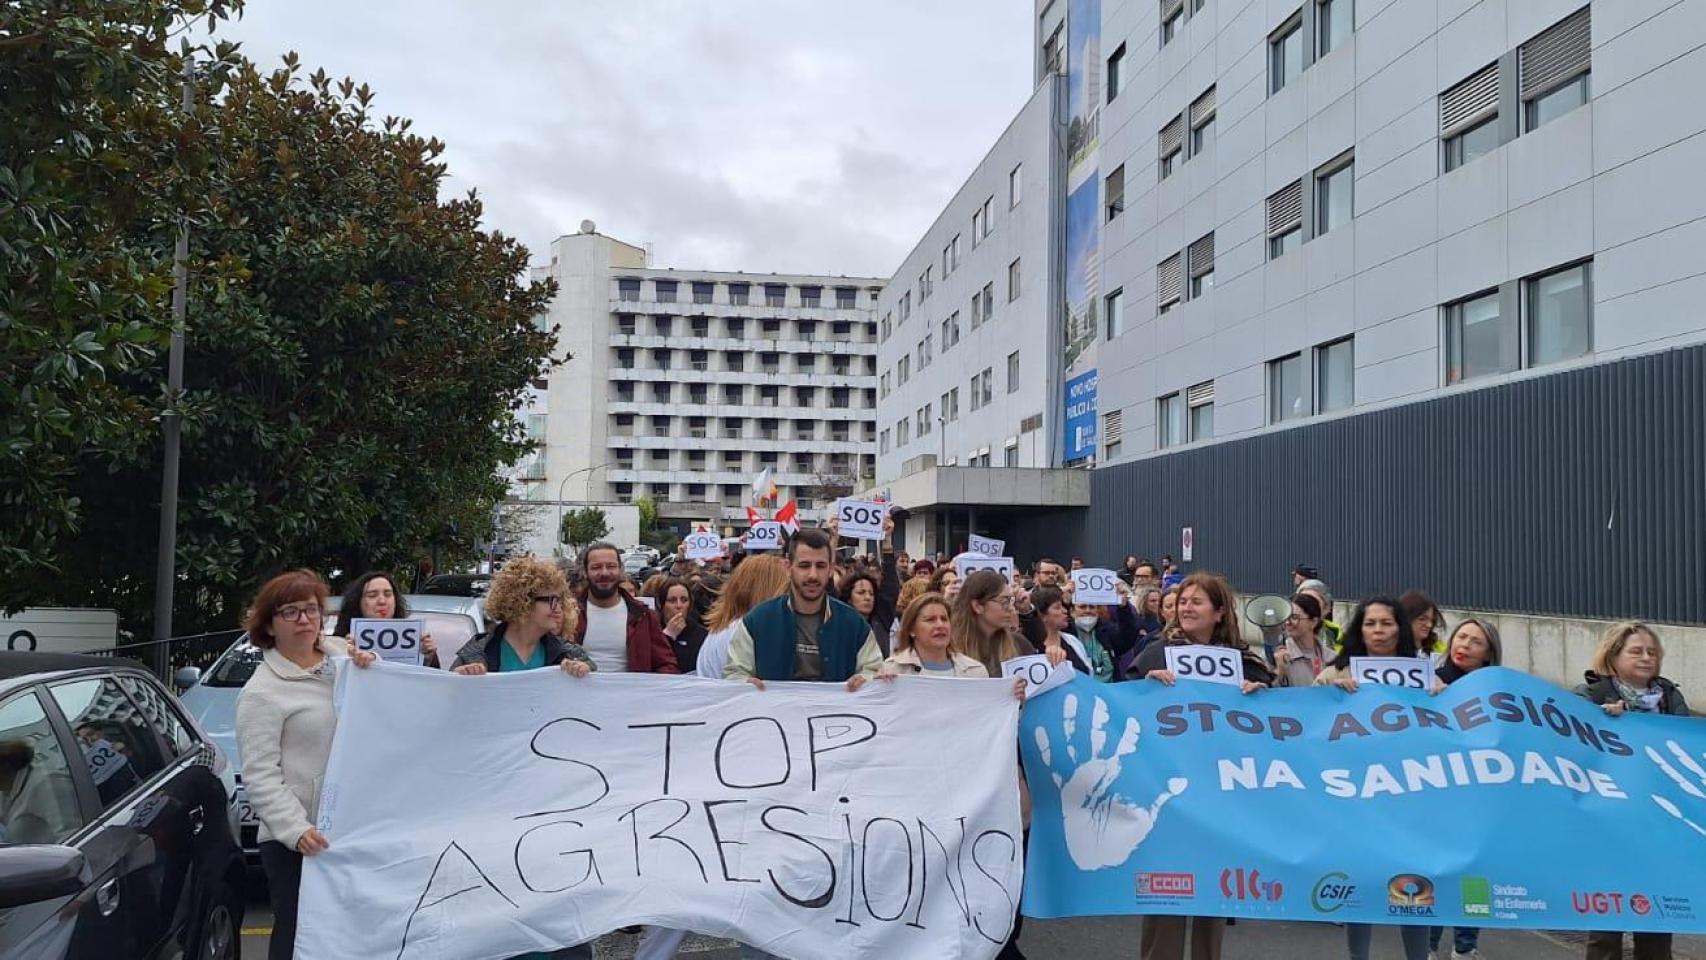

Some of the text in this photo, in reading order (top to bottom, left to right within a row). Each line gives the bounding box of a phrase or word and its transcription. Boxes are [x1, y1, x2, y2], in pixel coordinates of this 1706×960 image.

[842, 506, 881, 525] SOS
[689, 536, 718, 550] SOS
[748, 527, 776, 540] SOS
[973, 540, 999, 555] SOS
[1078, 574, 1115, 591] SOS
[359, 628, 417, 650] SOS
[1177, 654, 1235, 678] SOS
[1156, 691, 1633, 756] STOP AGRESIÓNS
[514, 713, 877, 819] STOP
[1217, 748, 1629, 799] NA SANIDADE
[1320, 884, 1356, 900] CSIF
[1572, 892, 1623, 915] UGT
